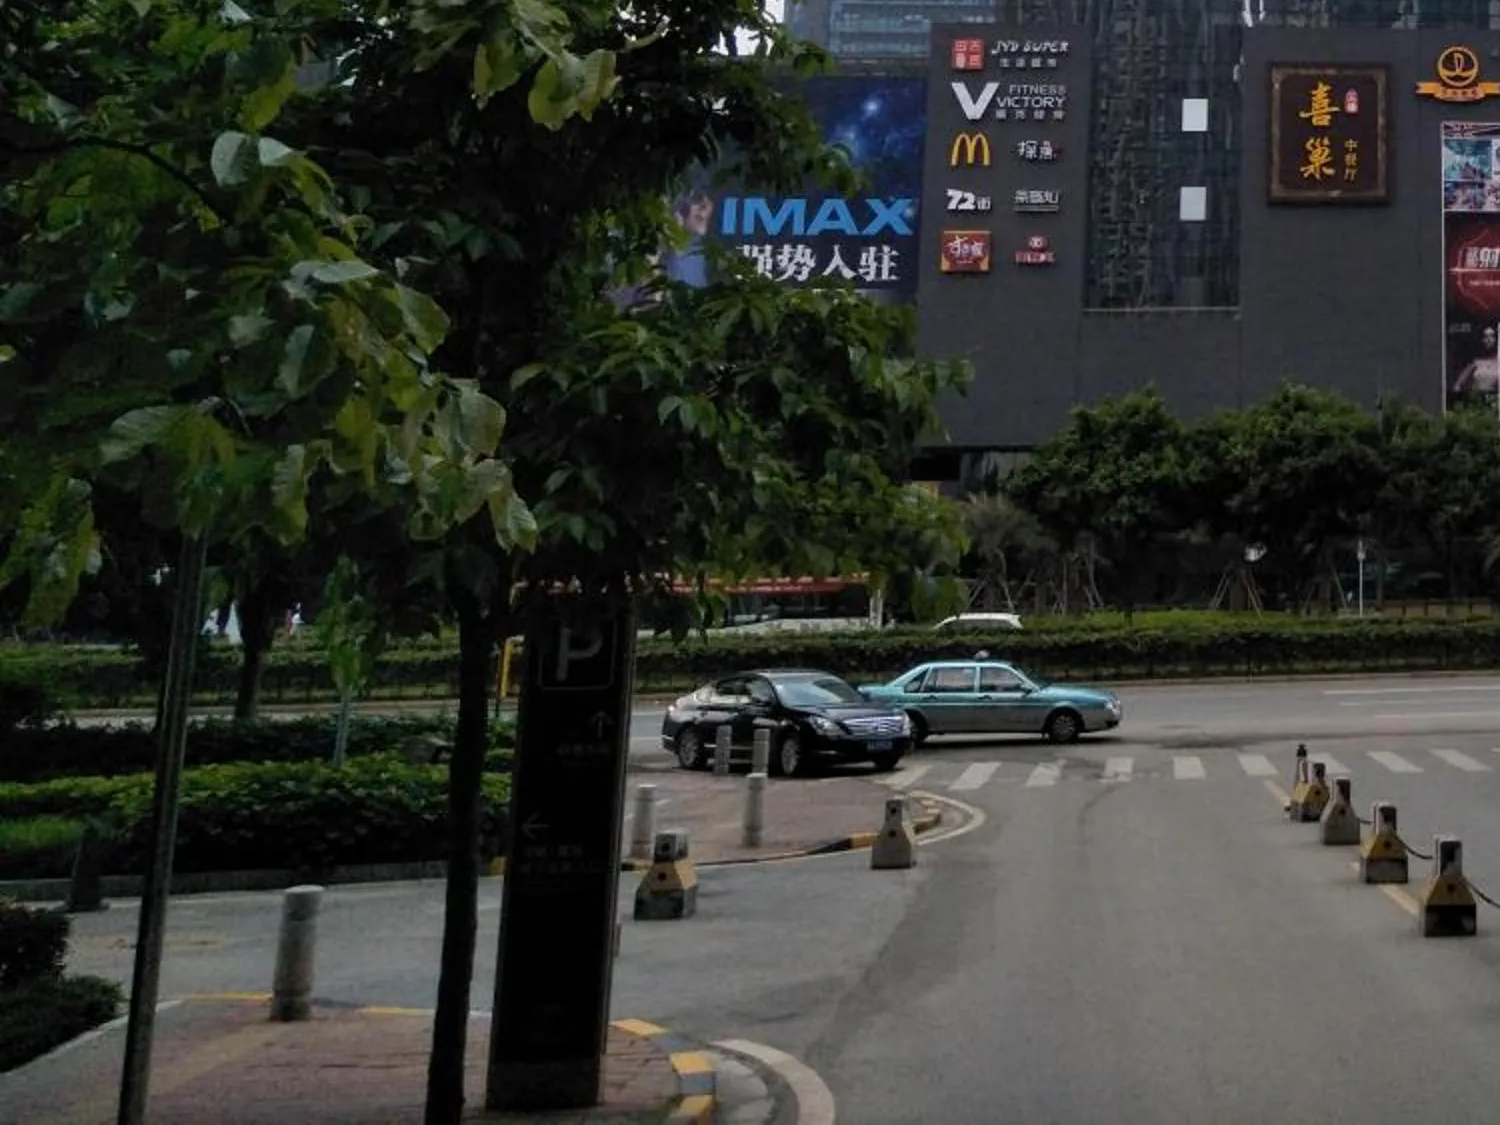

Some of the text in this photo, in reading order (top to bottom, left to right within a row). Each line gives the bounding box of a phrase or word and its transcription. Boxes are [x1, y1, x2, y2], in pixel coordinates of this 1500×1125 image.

[1022, 40, 1069, 53] SUPER
[1009, 84, 1067, 95] FITNESS
[996, 96, 1066, 108] VICTORY
[721, 197, 914, 236] IMAX
